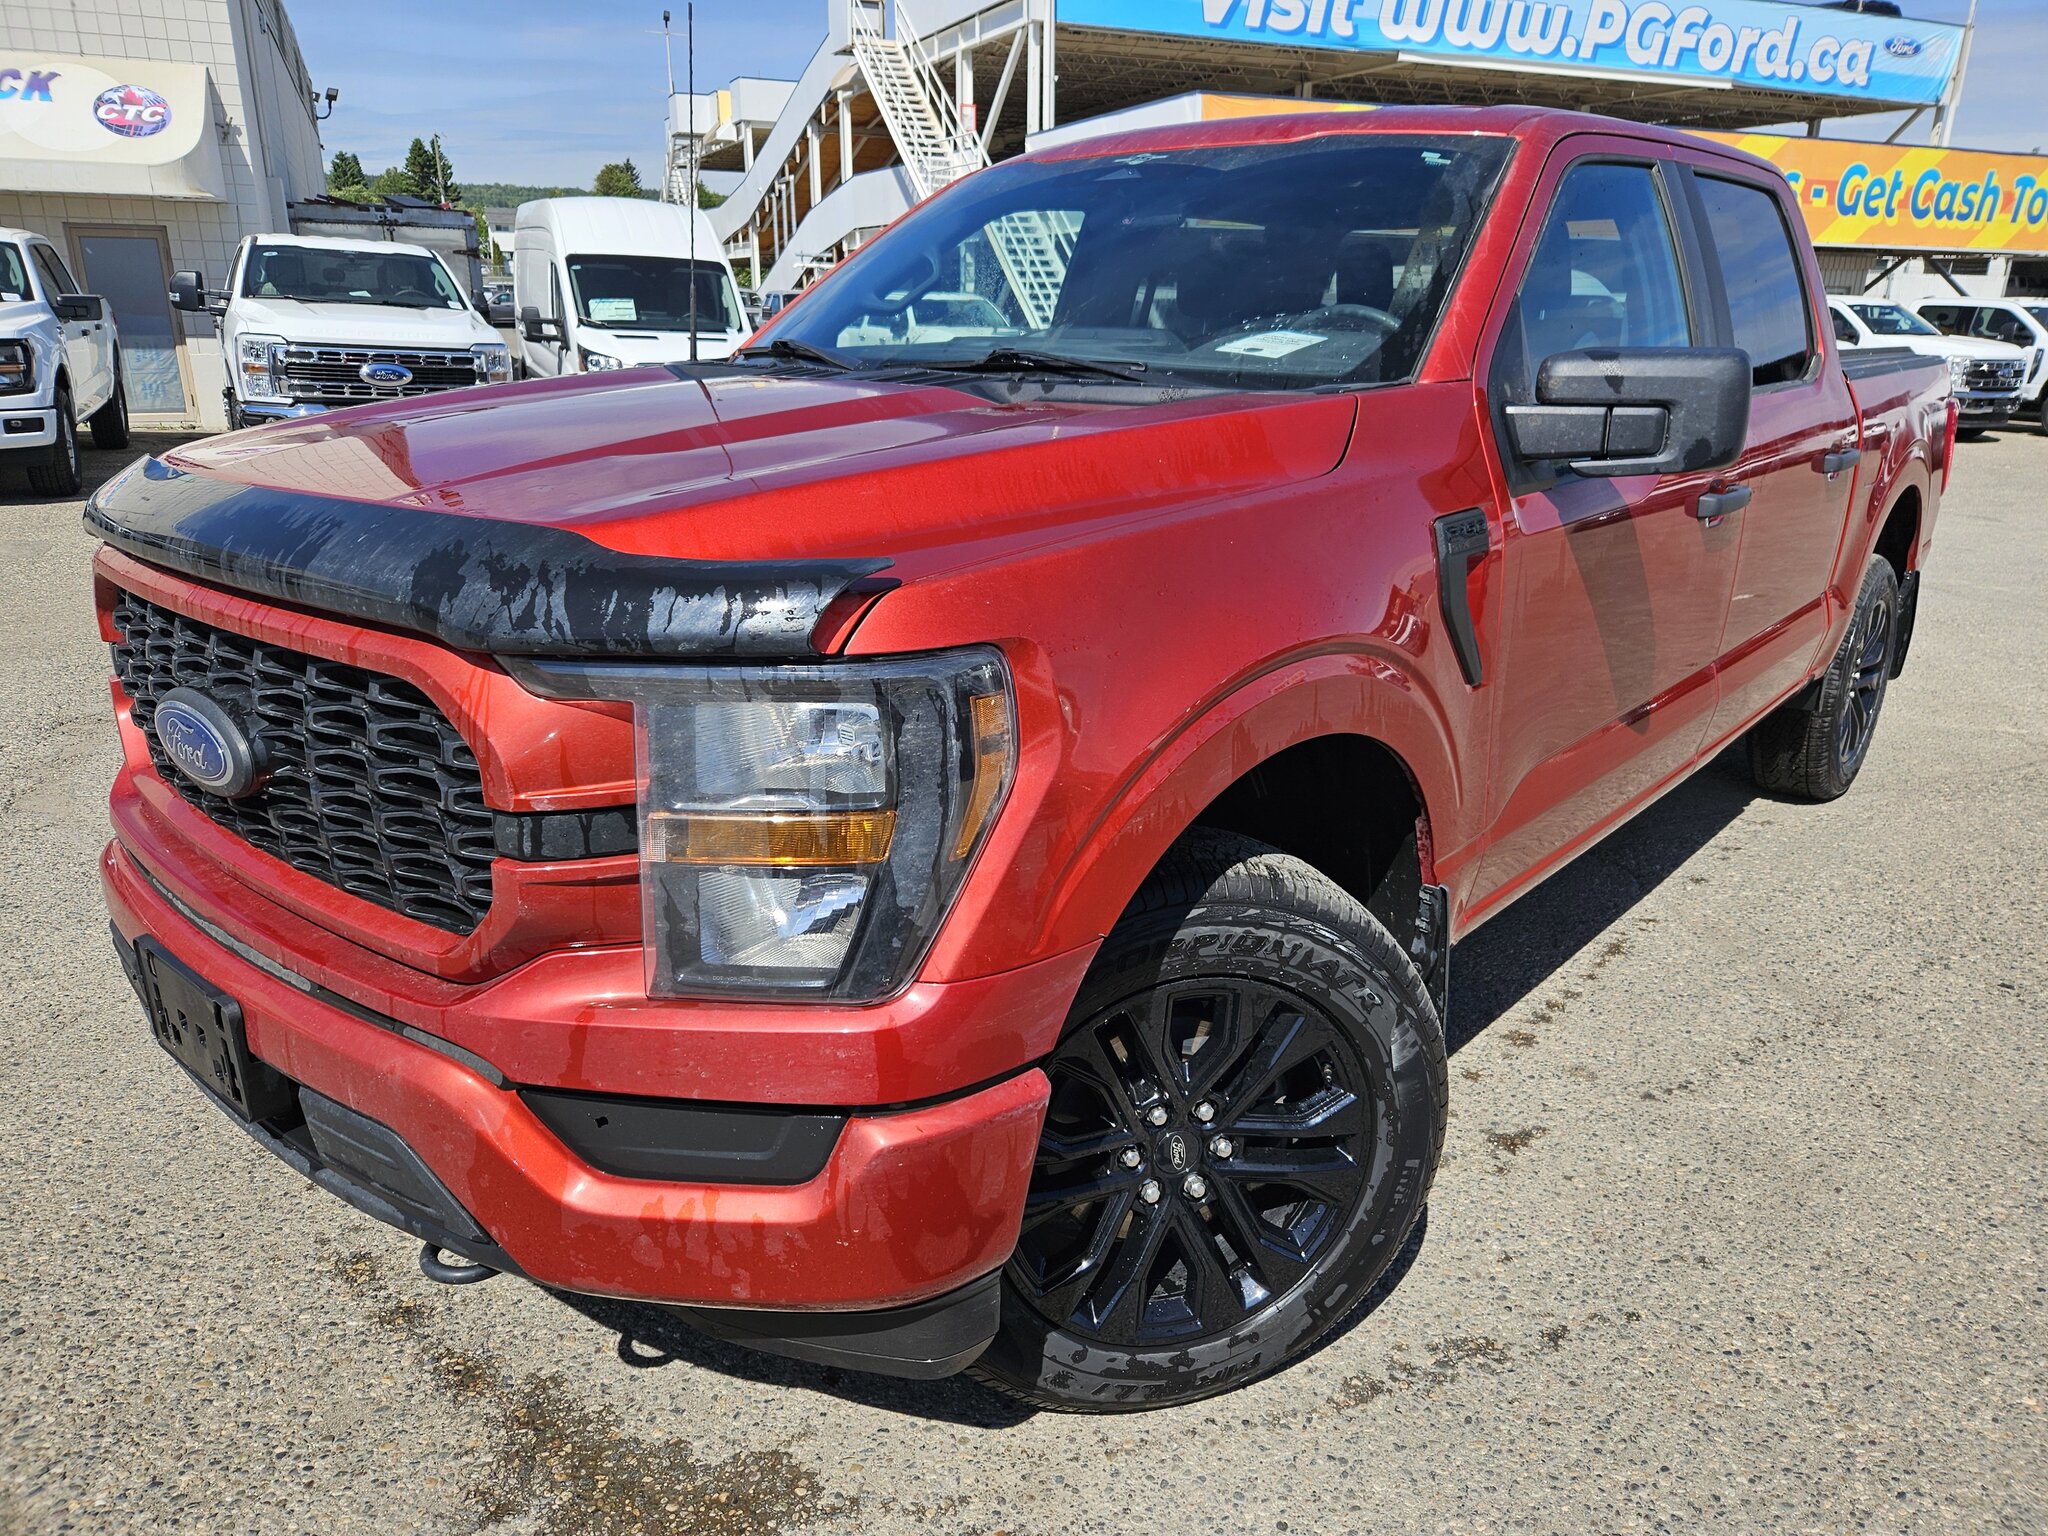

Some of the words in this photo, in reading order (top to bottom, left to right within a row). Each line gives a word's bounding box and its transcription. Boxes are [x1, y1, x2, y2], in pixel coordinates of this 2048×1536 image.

[1379, 0, 1874, 88] www.PGFord.ca
[97, 103, 166, 123] CTC
[1837, 163, 1903, 219] Get
[1910, 168, 2001, 223] Cash
[165, 717, 209, 770] Ford
